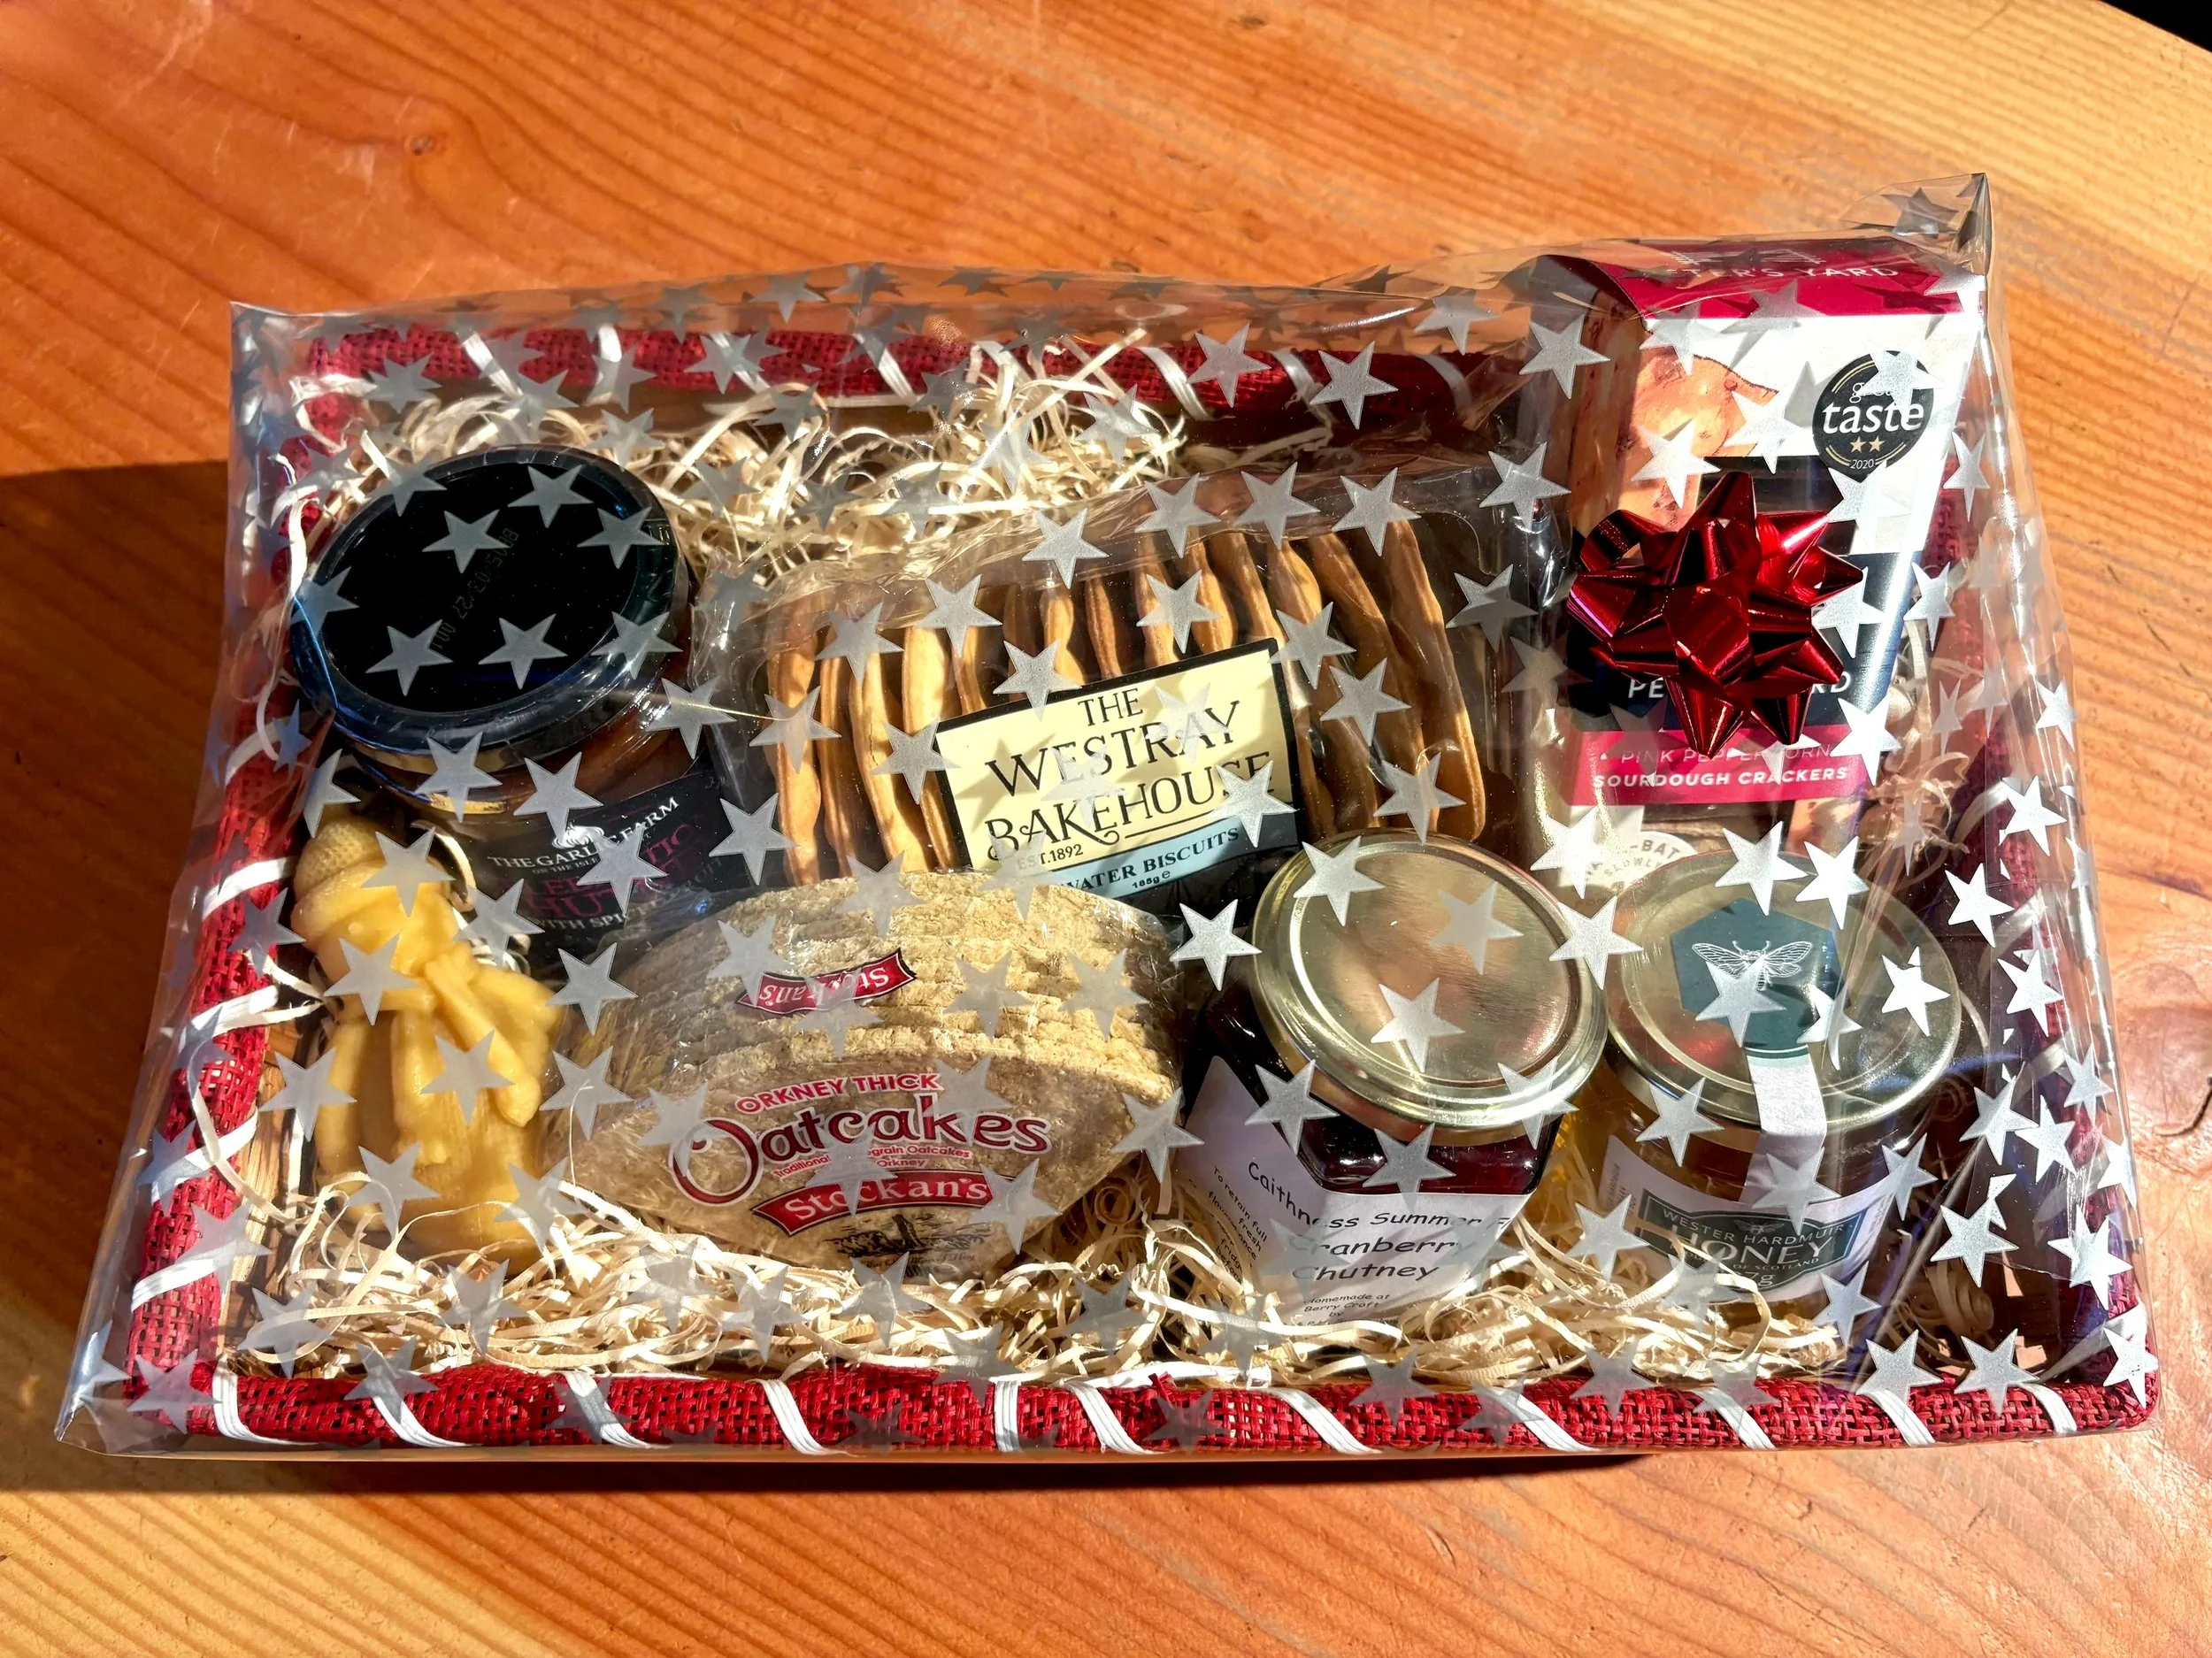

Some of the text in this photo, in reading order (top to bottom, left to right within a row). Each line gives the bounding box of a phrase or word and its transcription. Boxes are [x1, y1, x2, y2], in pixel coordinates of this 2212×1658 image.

[1793, 267, 1899, 278] YARD
[1822, 402, 1924, 434] taste
[1850, 458, 1875, 470] 2020
[1078, 687, 1143, 726] THE
[985, 700, 1240, 797] WESTRAY
[1621, 745, 1831, 764] PINK PEPPERORN
[1594, 766, 1848, 787] SOURDOUGH CRACKERS
[487, 856, 535, 868] THE
[536, 834, 617, 865] GARL
[1018, 844, 1084, 871] EST.1892
[1143, 827, 1239, 873] BISCUITS
[736, 1073, 943, 1114] ORKNEY THICK
[670, 1094, 1051, 1206] Oatcakes
[773, 1154, 832, 1178] Traditional
[906, 1146, 972, 1159] Oatcakes
[876, 1158, 926, 1169] Orkney
[784, 1178, 988, 1221] Stockan's
[1213, 1166, 1224, 1183] To
[1225, 1184, 1251, 1220] retain
[1252, 1220, 1268, 1243] full
[1239, 1217, 1263, 1252] fresh
[1663, 1209, 1735, 1241] WESTER
[1743, 1224, 1845, 1245] HARDMUIR
[1293, 1263, 1440, 1281] Chutney
[1755, 1257, 1819, 1271] SCOTLAND
[1303, 1304, 1340, 1313] Berry
